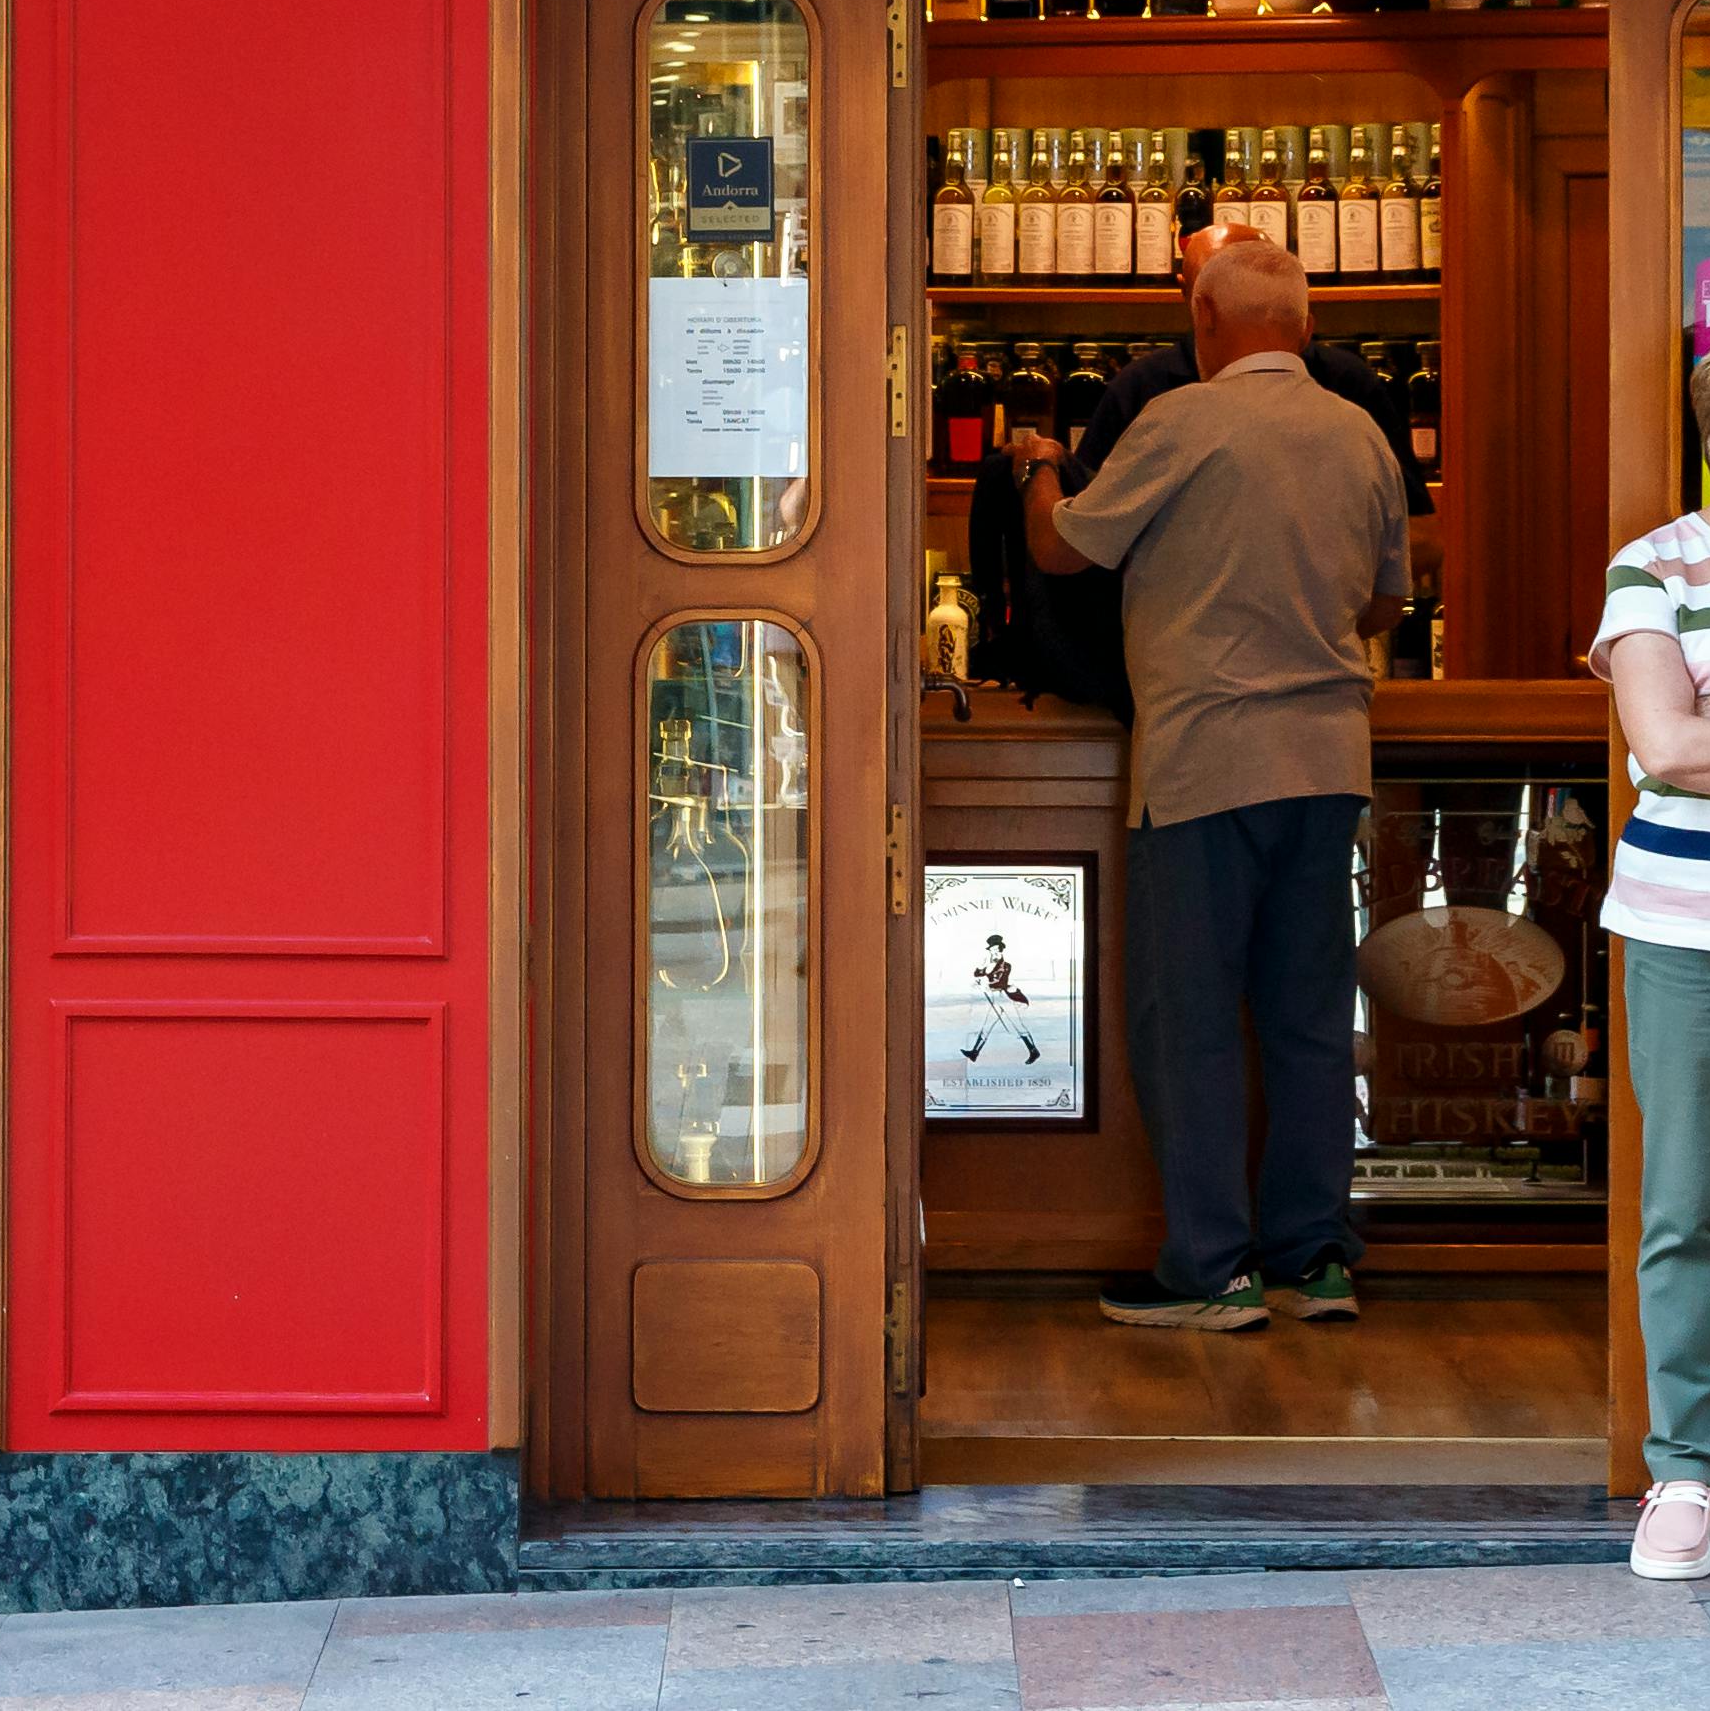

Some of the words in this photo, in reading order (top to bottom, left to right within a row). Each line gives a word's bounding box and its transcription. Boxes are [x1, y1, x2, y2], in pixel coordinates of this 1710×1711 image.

[702, 184, 759, 196] Andorra
[700, 215, 760, 224] SELECTED
[1395, 1040, 1523, 1079] IRISH
[942, 1077, 1024, 1088] ESTABLISHED
[1027, 1077, 1052, 1088] 1820
[1373, 1096, 1584, 1137] HISKEY
